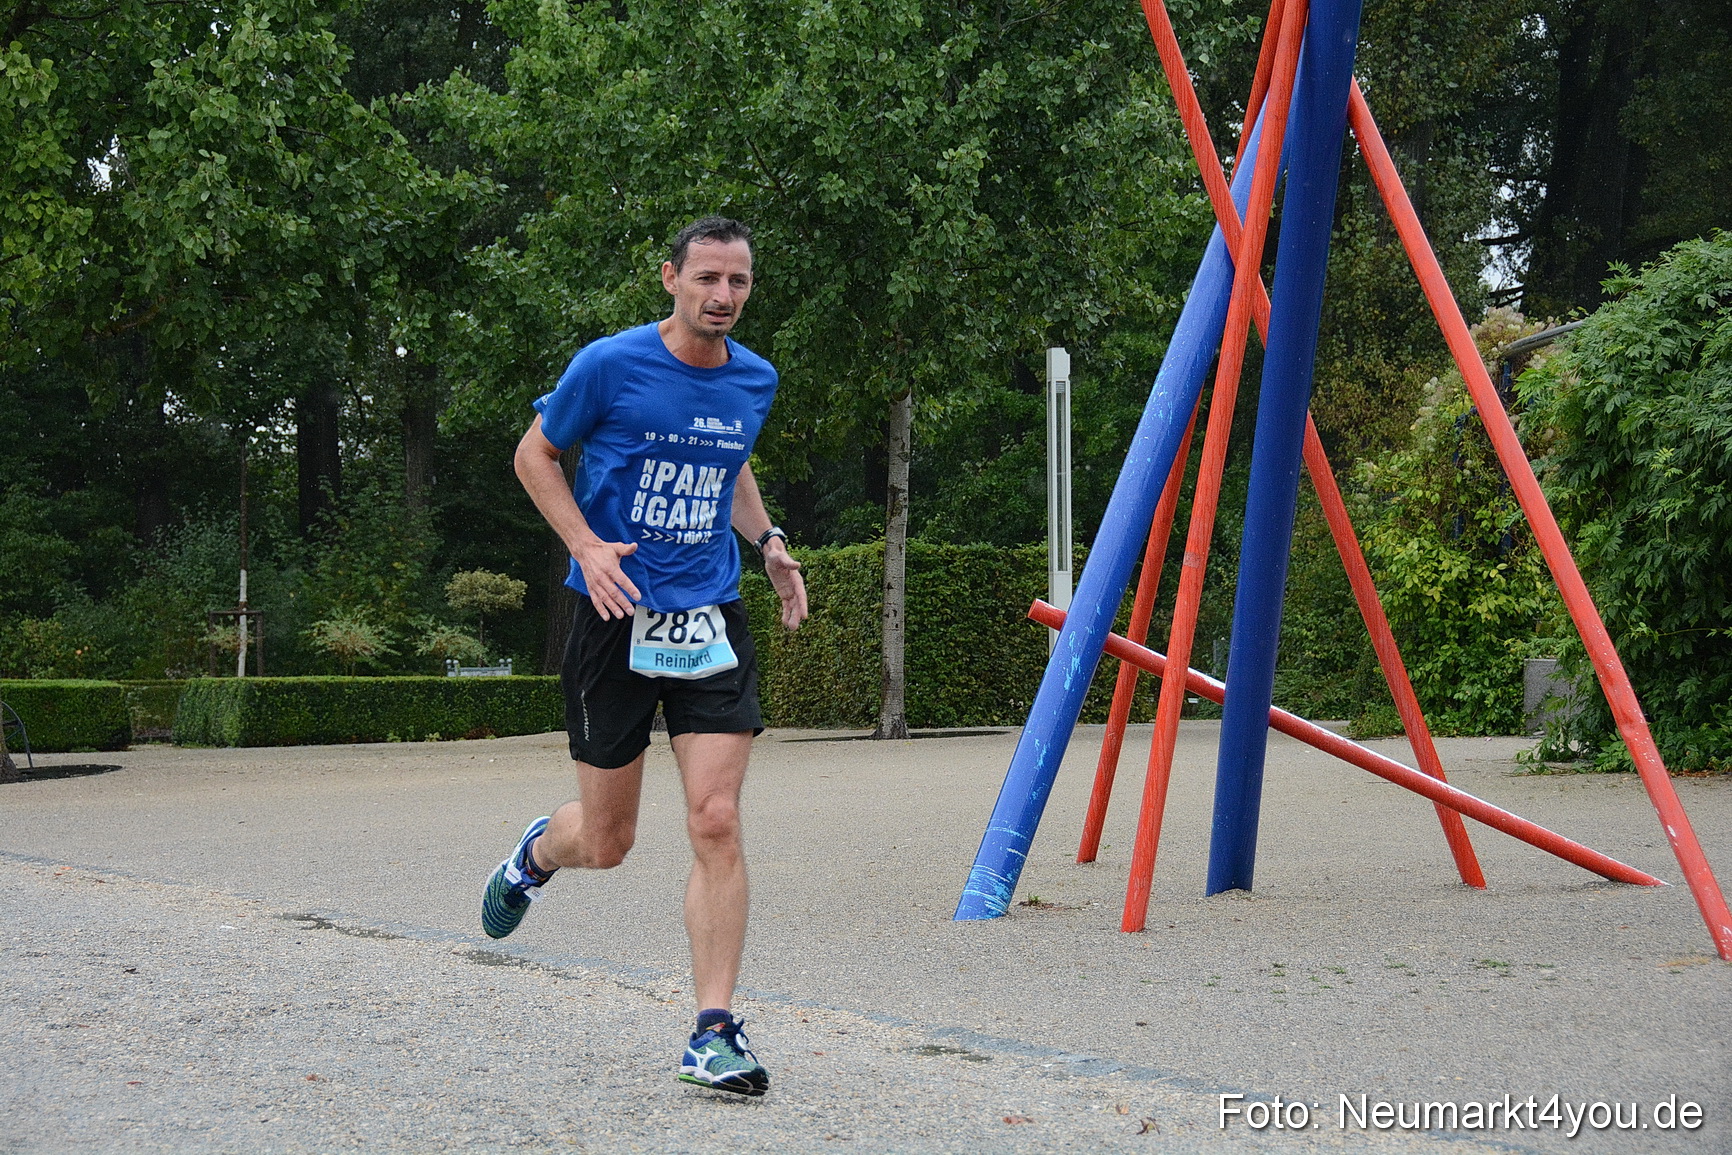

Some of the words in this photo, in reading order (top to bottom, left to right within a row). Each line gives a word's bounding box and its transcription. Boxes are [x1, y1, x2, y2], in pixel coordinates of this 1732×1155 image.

[693, 417, 707, 428] 26.
[668, 433, 679, 443] 90
[688, 436, 698, 445] 21
[717, 439, 745, 451] Finisher
[639, 458, 656, 489] NO
[652, 461, 727, 498] PAIN
[630, 491, 647, 522] NO
[644, 495, 719, 530] GAIN
